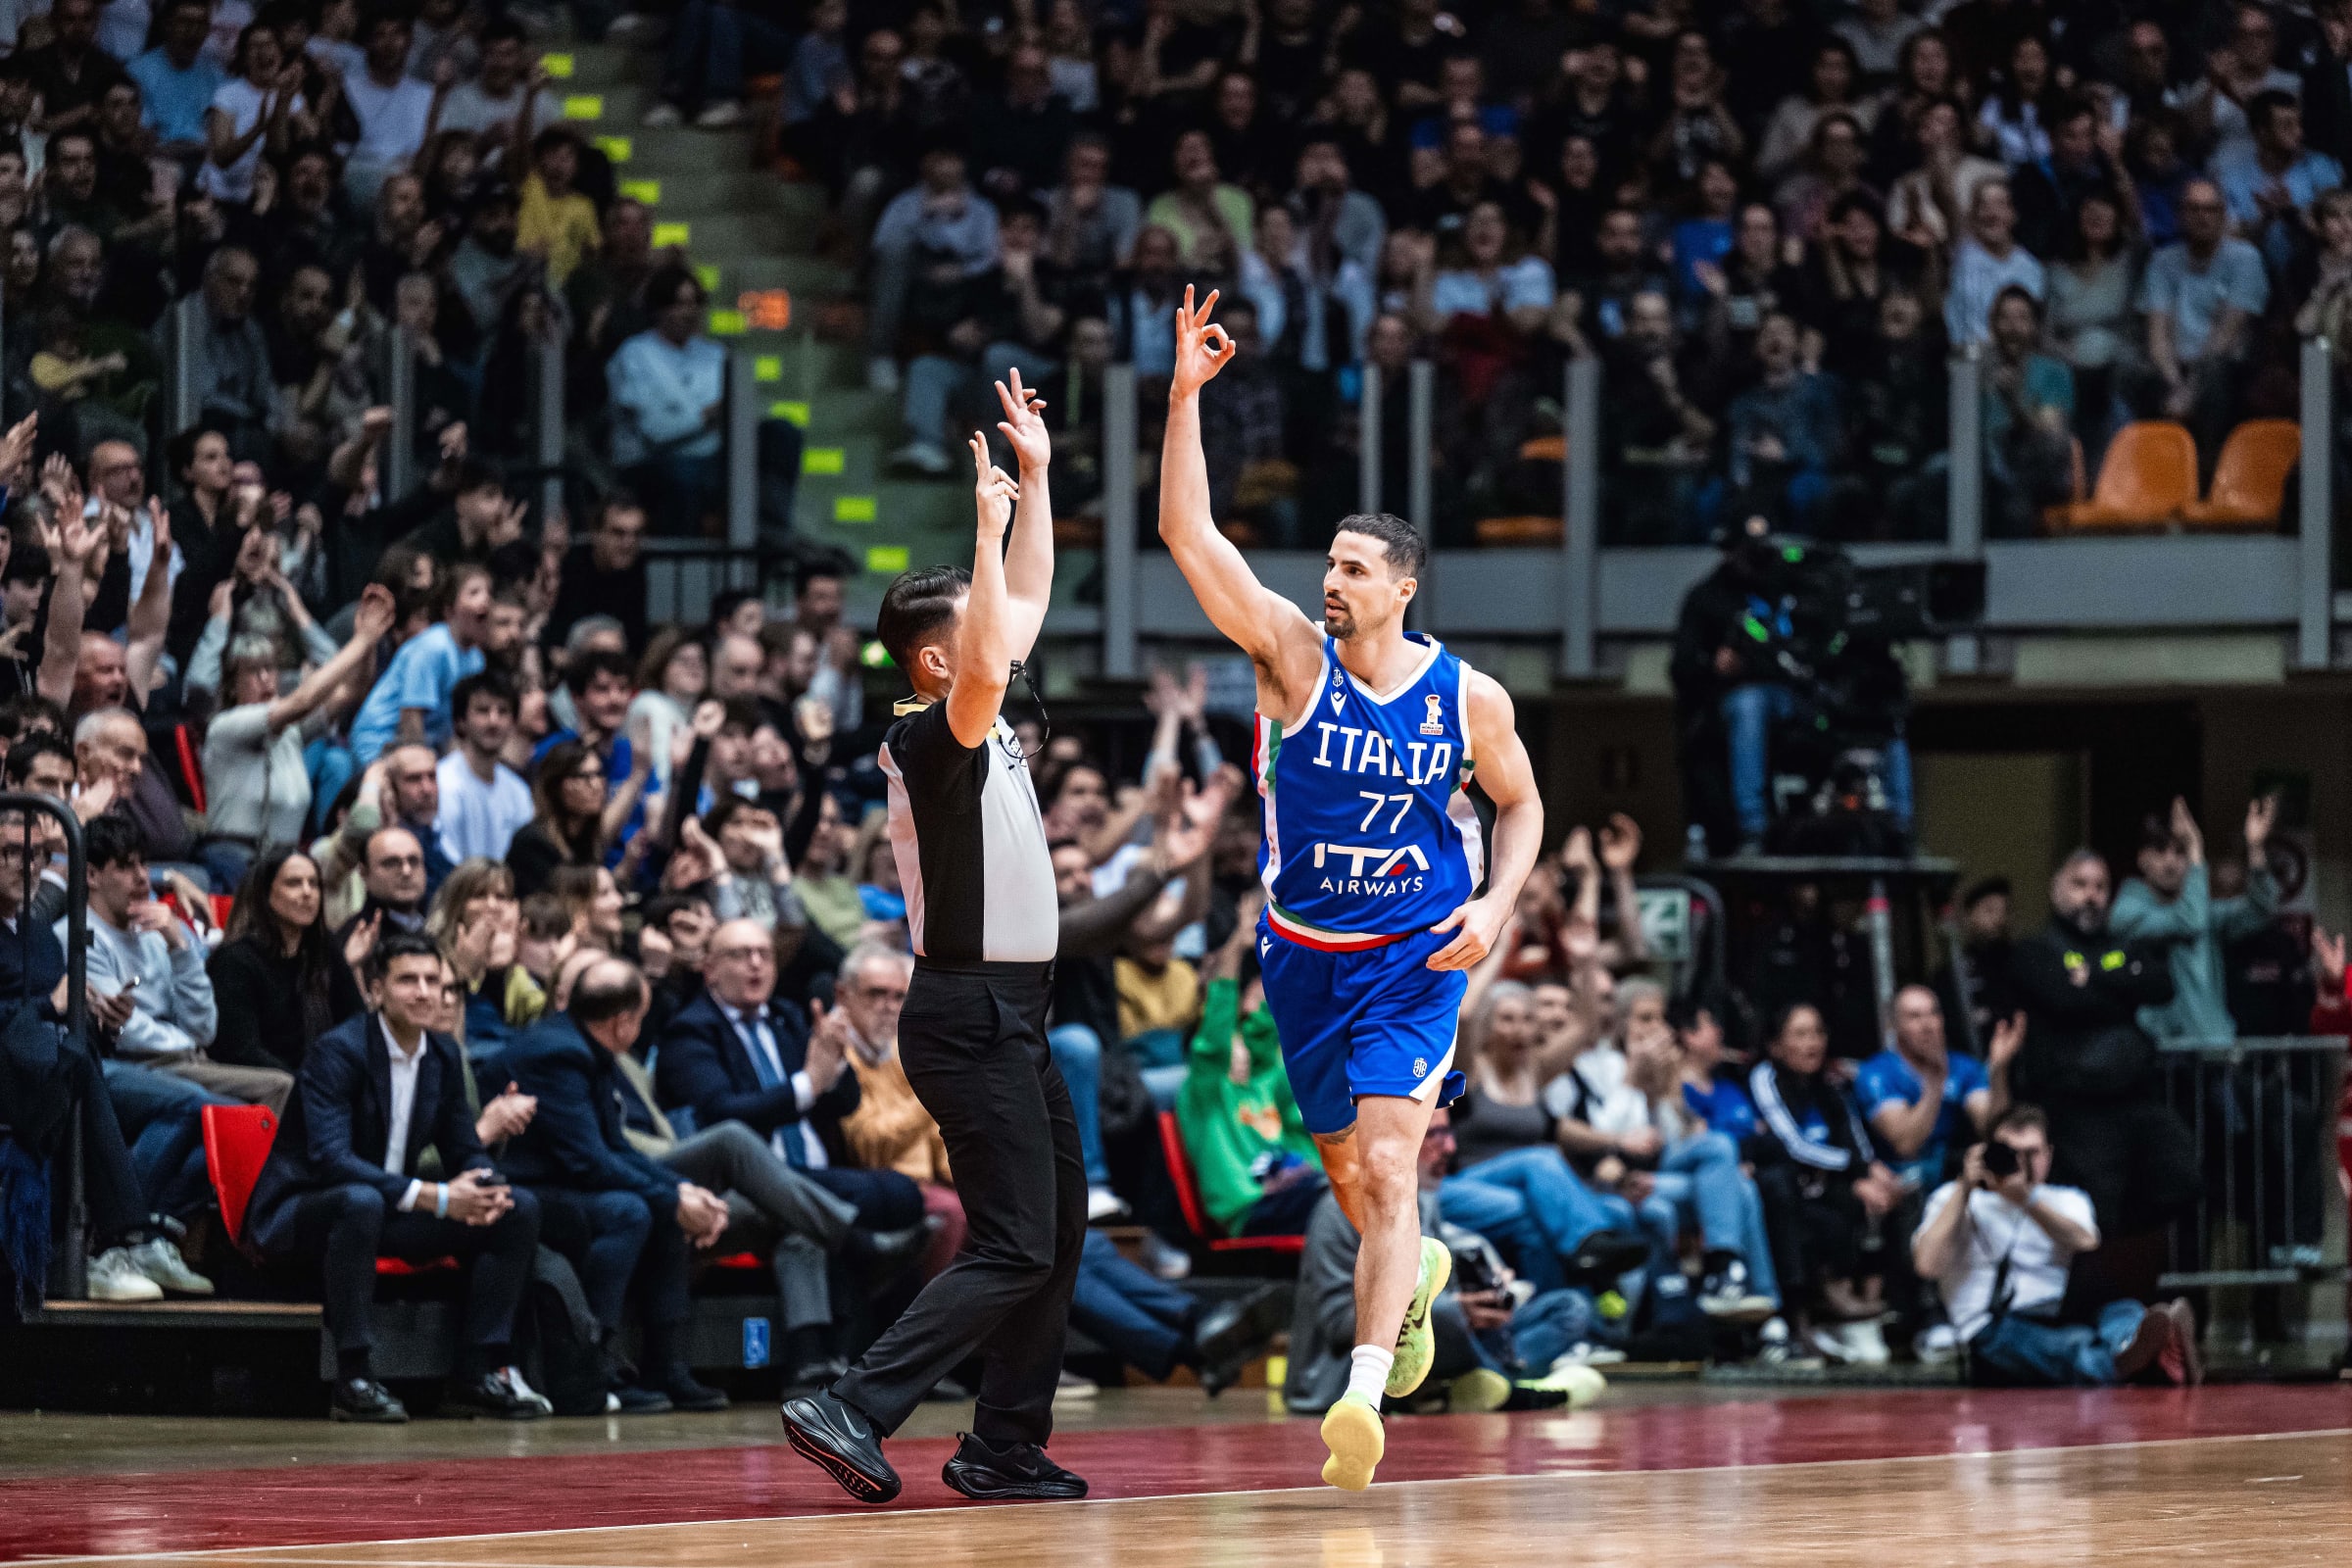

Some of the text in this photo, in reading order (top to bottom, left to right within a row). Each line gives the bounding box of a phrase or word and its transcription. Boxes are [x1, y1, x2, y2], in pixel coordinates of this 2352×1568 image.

[1312, 721, 1452, 786] ITALIA
[1359, 791, 1414, 834] 77
[1313, 843, 1431, 878] ITA
[1319, 875, 1424, 898] AIRWAYS
